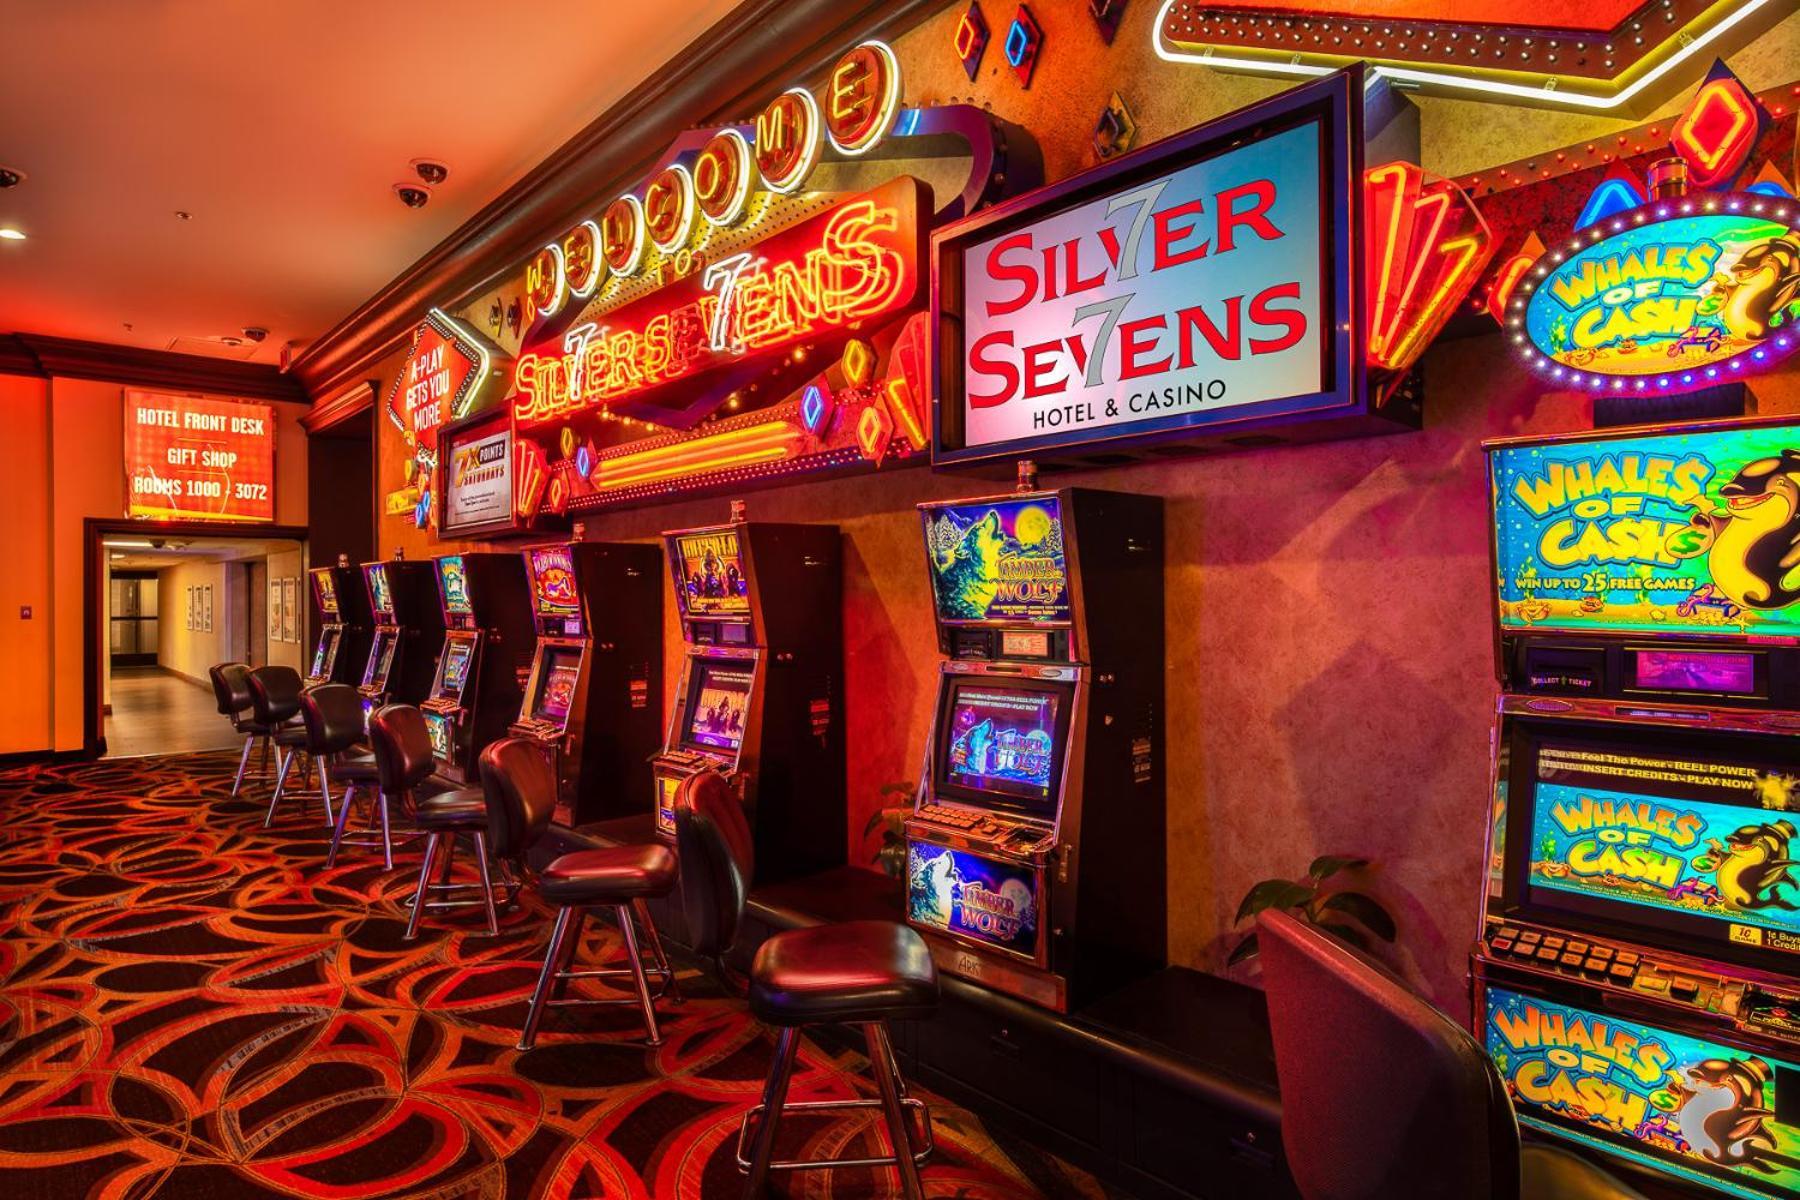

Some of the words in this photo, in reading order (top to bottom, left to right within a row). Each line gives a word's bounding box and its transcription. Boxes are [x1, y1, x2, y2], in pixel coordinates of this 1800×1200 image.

[527, 60, 860, 296] WELCOME
[655, 248, 692, 286] TO
[1550, 238, 1721, 309] WHALES
[1602, 280, 1662, 305] OF
[1572, 296, 1697, 348] CASH
[410, 343, 445, 384] A-PLAY
[406, 380, 428, 411] GETS
[429, 368, 450, 399] YOU
[1033, 398, 1096, 430] HOTEL
[1104, 397, 1119, 417] &
[1128, 378, 1227, 413] CASINO
[137, 407, 180, 428] HOTEL
[184, 412, 227, 432] FRONT
[231, 416, 265, 436] DESK
[414, 400, 441, 433] MORE
[167, 448, 197, 466] GIFT
[202, 451, 237, 468] SHOP
[480, 443, 504, 462] POINTS
[134, 476, 182, 495] ROOMS
[186, 480, 221, 497] 1000
[235, 483, 267, 500] 3072
[1512, 455, 1711, 517] WHALES
[1573, 496, 1644, 518] OF
[1539, 517, 1684, 567] CASH
[1516, 577, 1542, 590] WIN
[1543, 577, 1561, 590] UP
[1561, 577, 1581, 590] TO
[1582, 573, 1608, 593] 25
[1609, 577, 1643, 590] FREE
[1643, 577, 1696, 591] GAMES
[1626, 768, 1677, 782] CREDITS
[1686, 774, 1720, 786] PLAY
[1721, 778, 1754, 790] NOW
[1709, 764, 1757, 778] POWER
[1552, 797, 1704, 849] WHALES
[1598, 828, 1652, 846] OF
[1567, 840, 1684, 888] CASH
[1492, 1003, 1676, 1085] WHALES
[1546, 1049, 1612, 1076] OF
[1514, 1058, 1649, 1132] CASH
